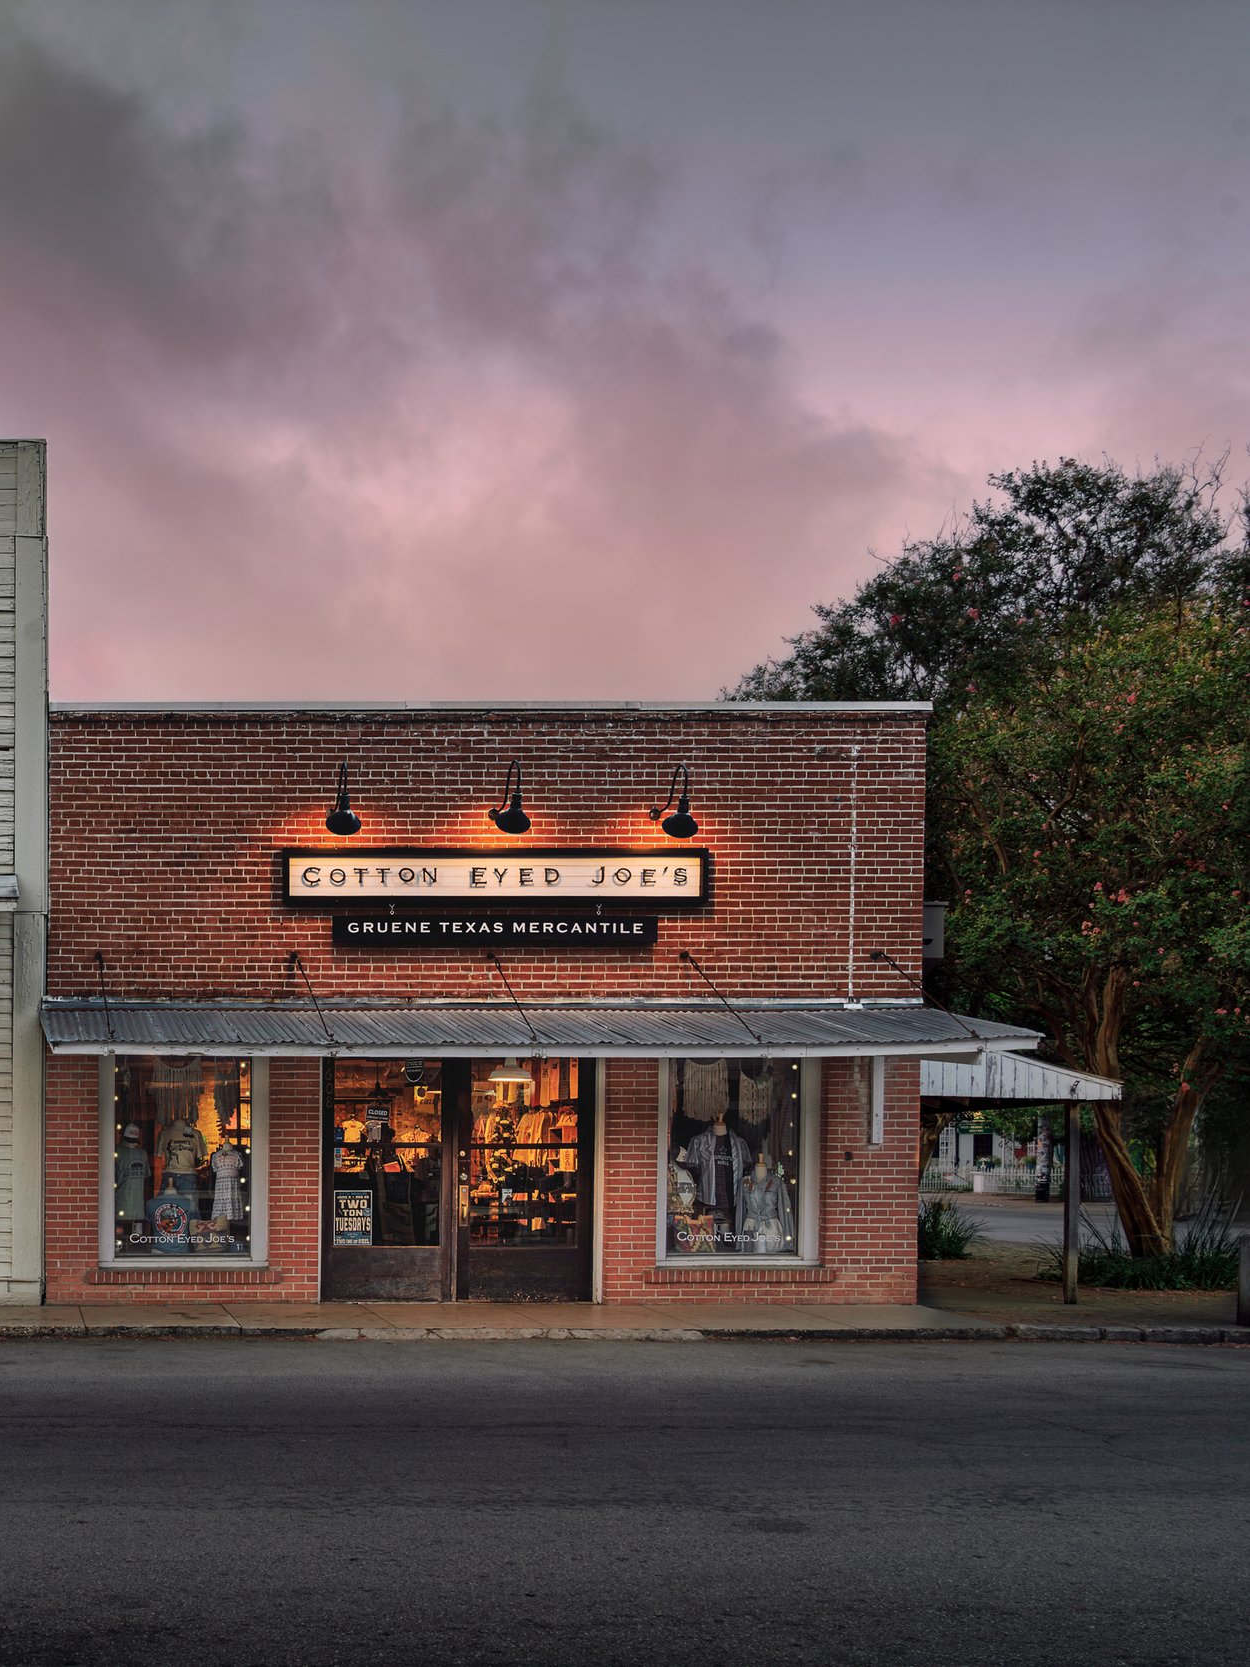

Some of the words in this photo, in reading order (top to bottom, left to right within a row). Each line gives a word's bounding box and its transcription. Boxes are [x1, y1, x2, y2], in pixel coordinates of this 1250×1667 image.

[302, 866, 439, 886] COTTON
[471, 866, 561, 887] EYED
[591, 865, 689, 887] JOE'S
[347, 921, 430, 934] GRUENE
[439, 921, 505, 934] TEXAS
[512, 922, 645, 935] MERCANTILE
[339, 1199, 368, 1209] TWO
[342, 1209, 363, 1217] TON
[335, 1216, 371, 1231] TUESDAYS
[129, 1233, 176, 1244] COTTON
[177, 1233, 204, 1244] EYED
[205, 1232, 235, 1244] JOE'S
[676, 1231, 721, 1242] COTTON
[723, 1232, 750, 1242] EYED
[751, 1231, 781, 1242] JOE'S
